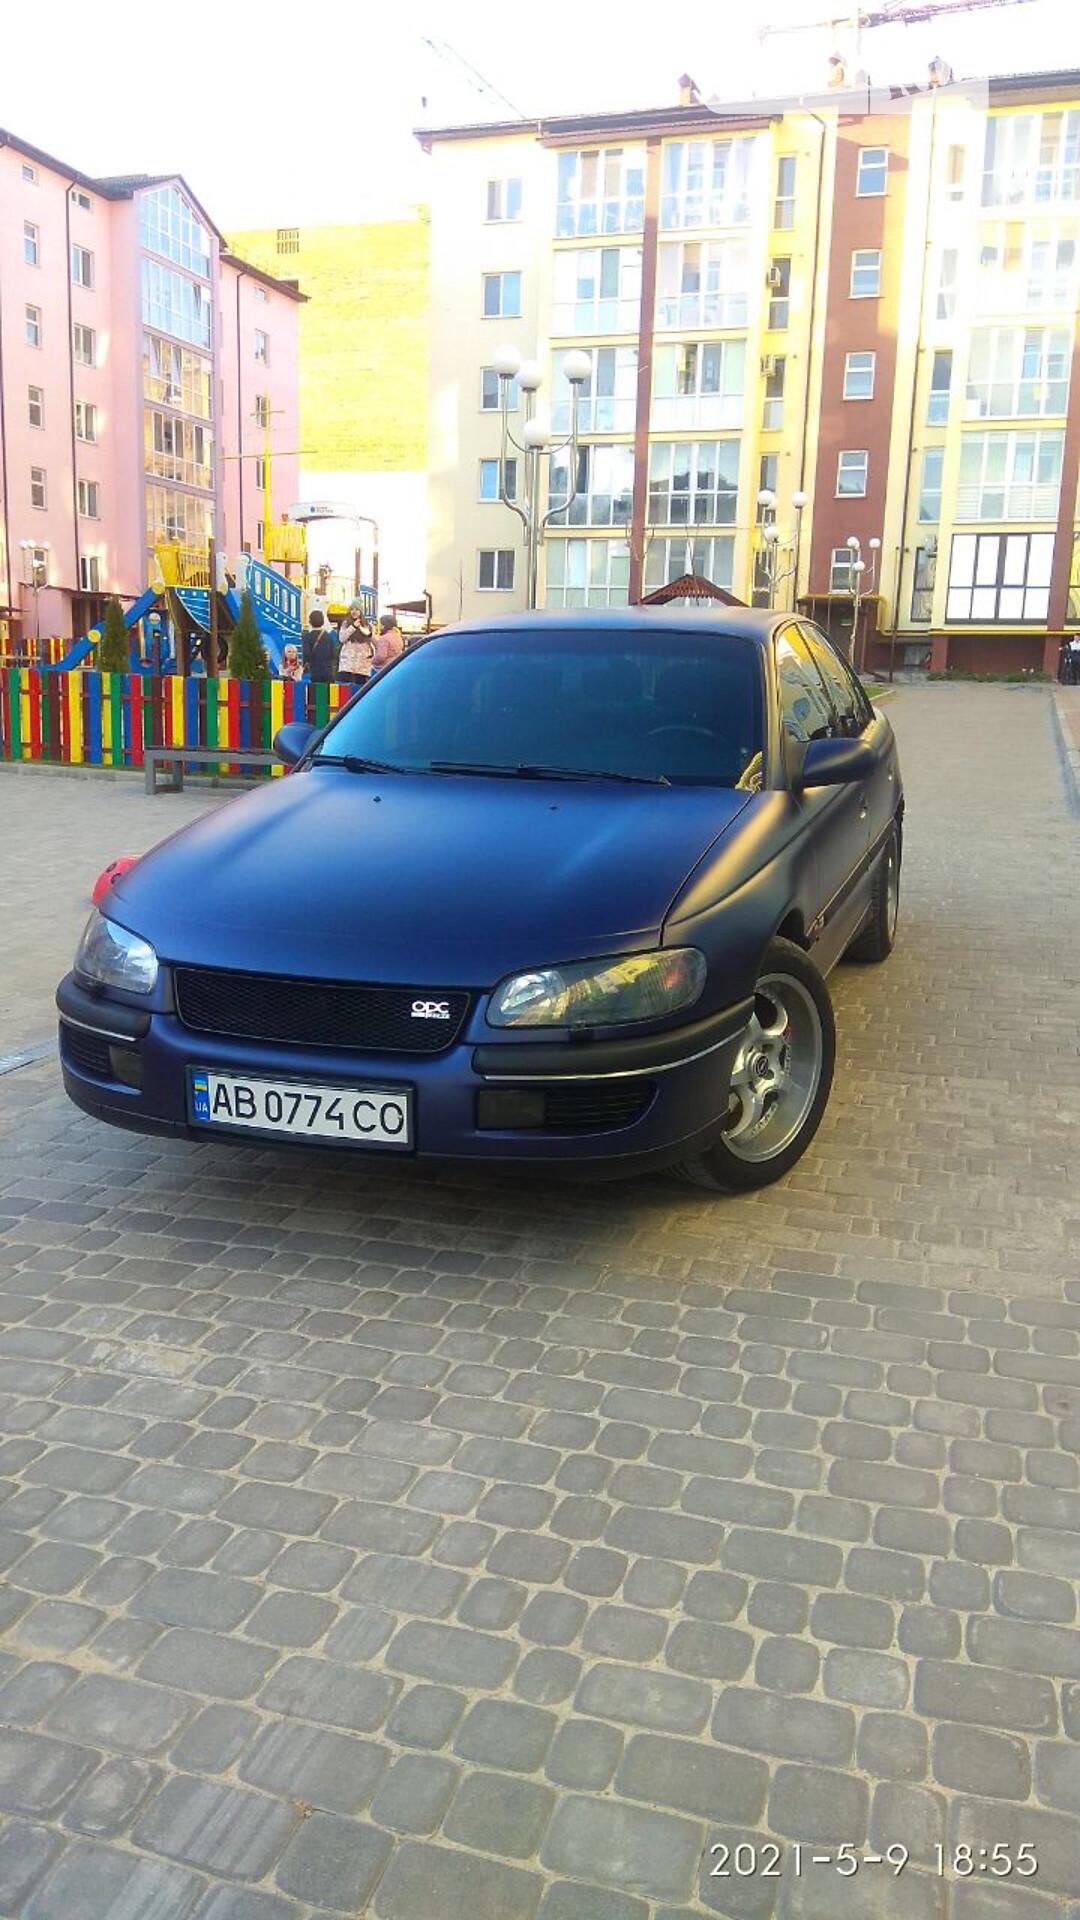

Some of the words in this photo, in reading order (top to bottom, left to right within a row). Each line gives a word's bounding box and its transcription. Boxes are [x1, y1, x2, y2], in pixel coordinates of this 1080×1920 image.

[195, 1103, 208, 1113] UA
[212, 1083, 257, 1119] AB
[264, 1090, 345, 1131] 0774
[353, 1100, 404, 1135] CO
